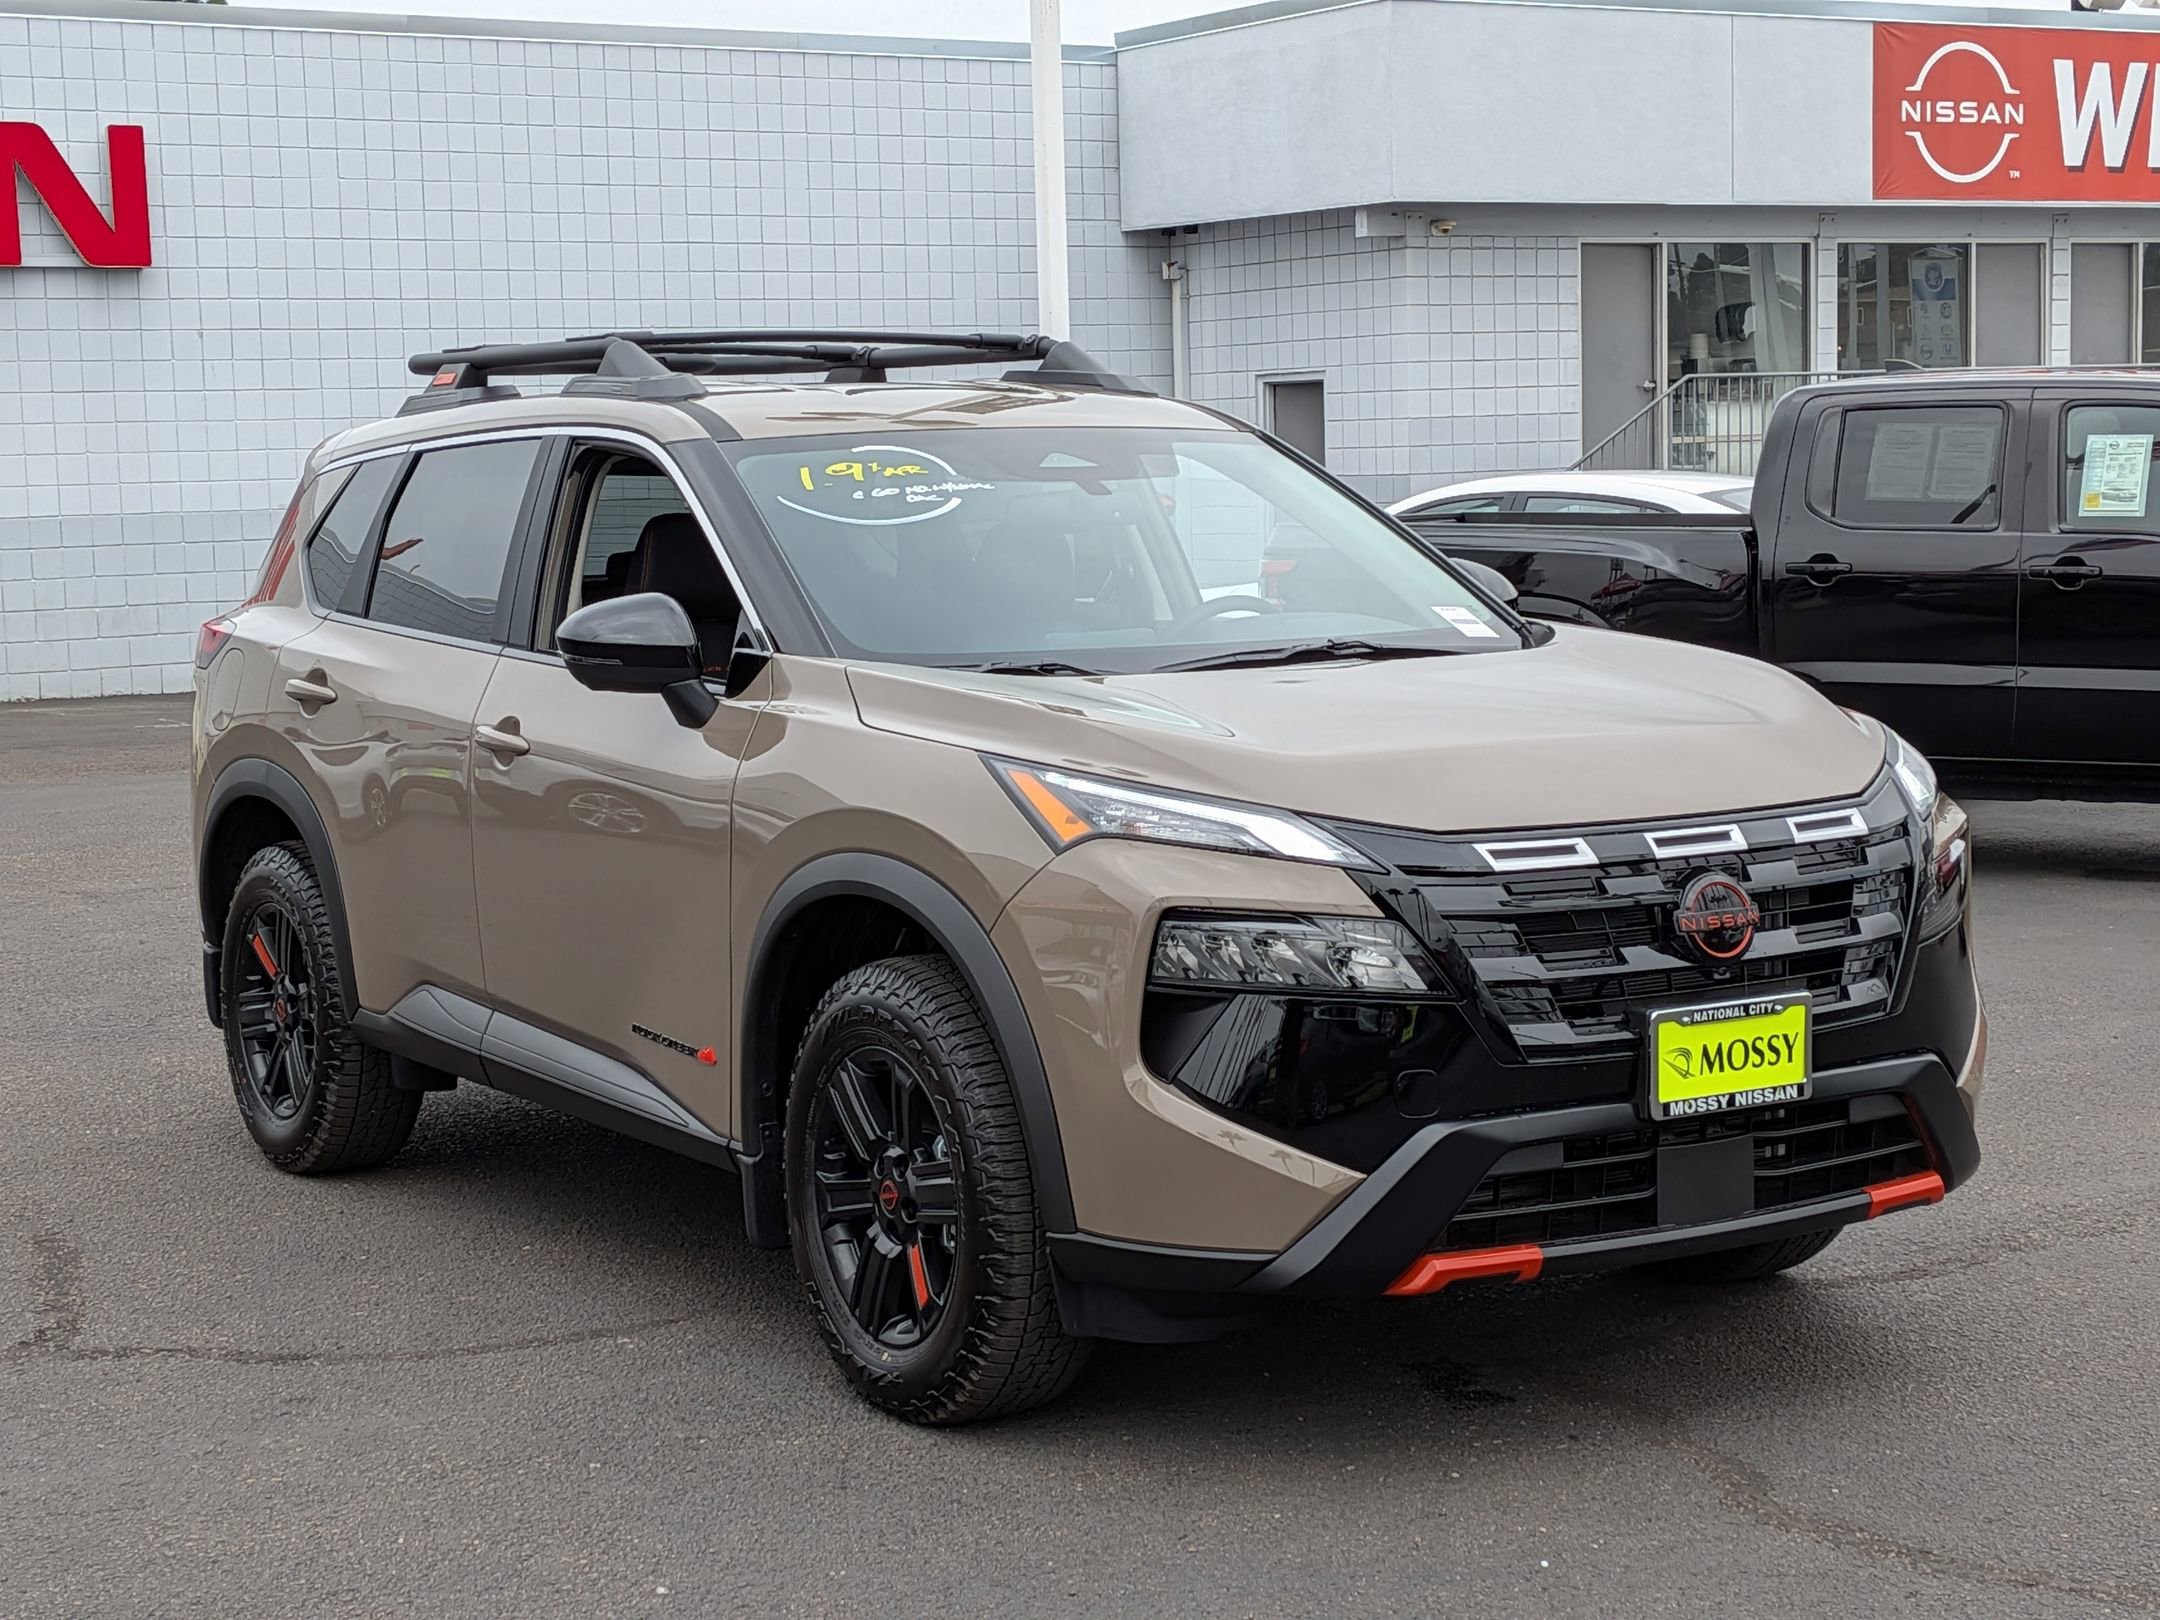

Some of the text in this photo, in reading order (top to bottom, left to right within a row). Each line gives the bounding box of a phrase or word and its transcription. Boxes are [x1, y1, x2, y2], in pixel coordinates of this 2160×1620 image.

[1901, 100, 2024, 124] NISSAN
[1680, 910, 1760, 930] NISSAN
[1693, 1002, 1774, 1023] NATIONAL CITY
[1699, 1032, 1799, 1076] MOSSY
[1669, 1084, 1798, 1117] MOSSY NISSAN
